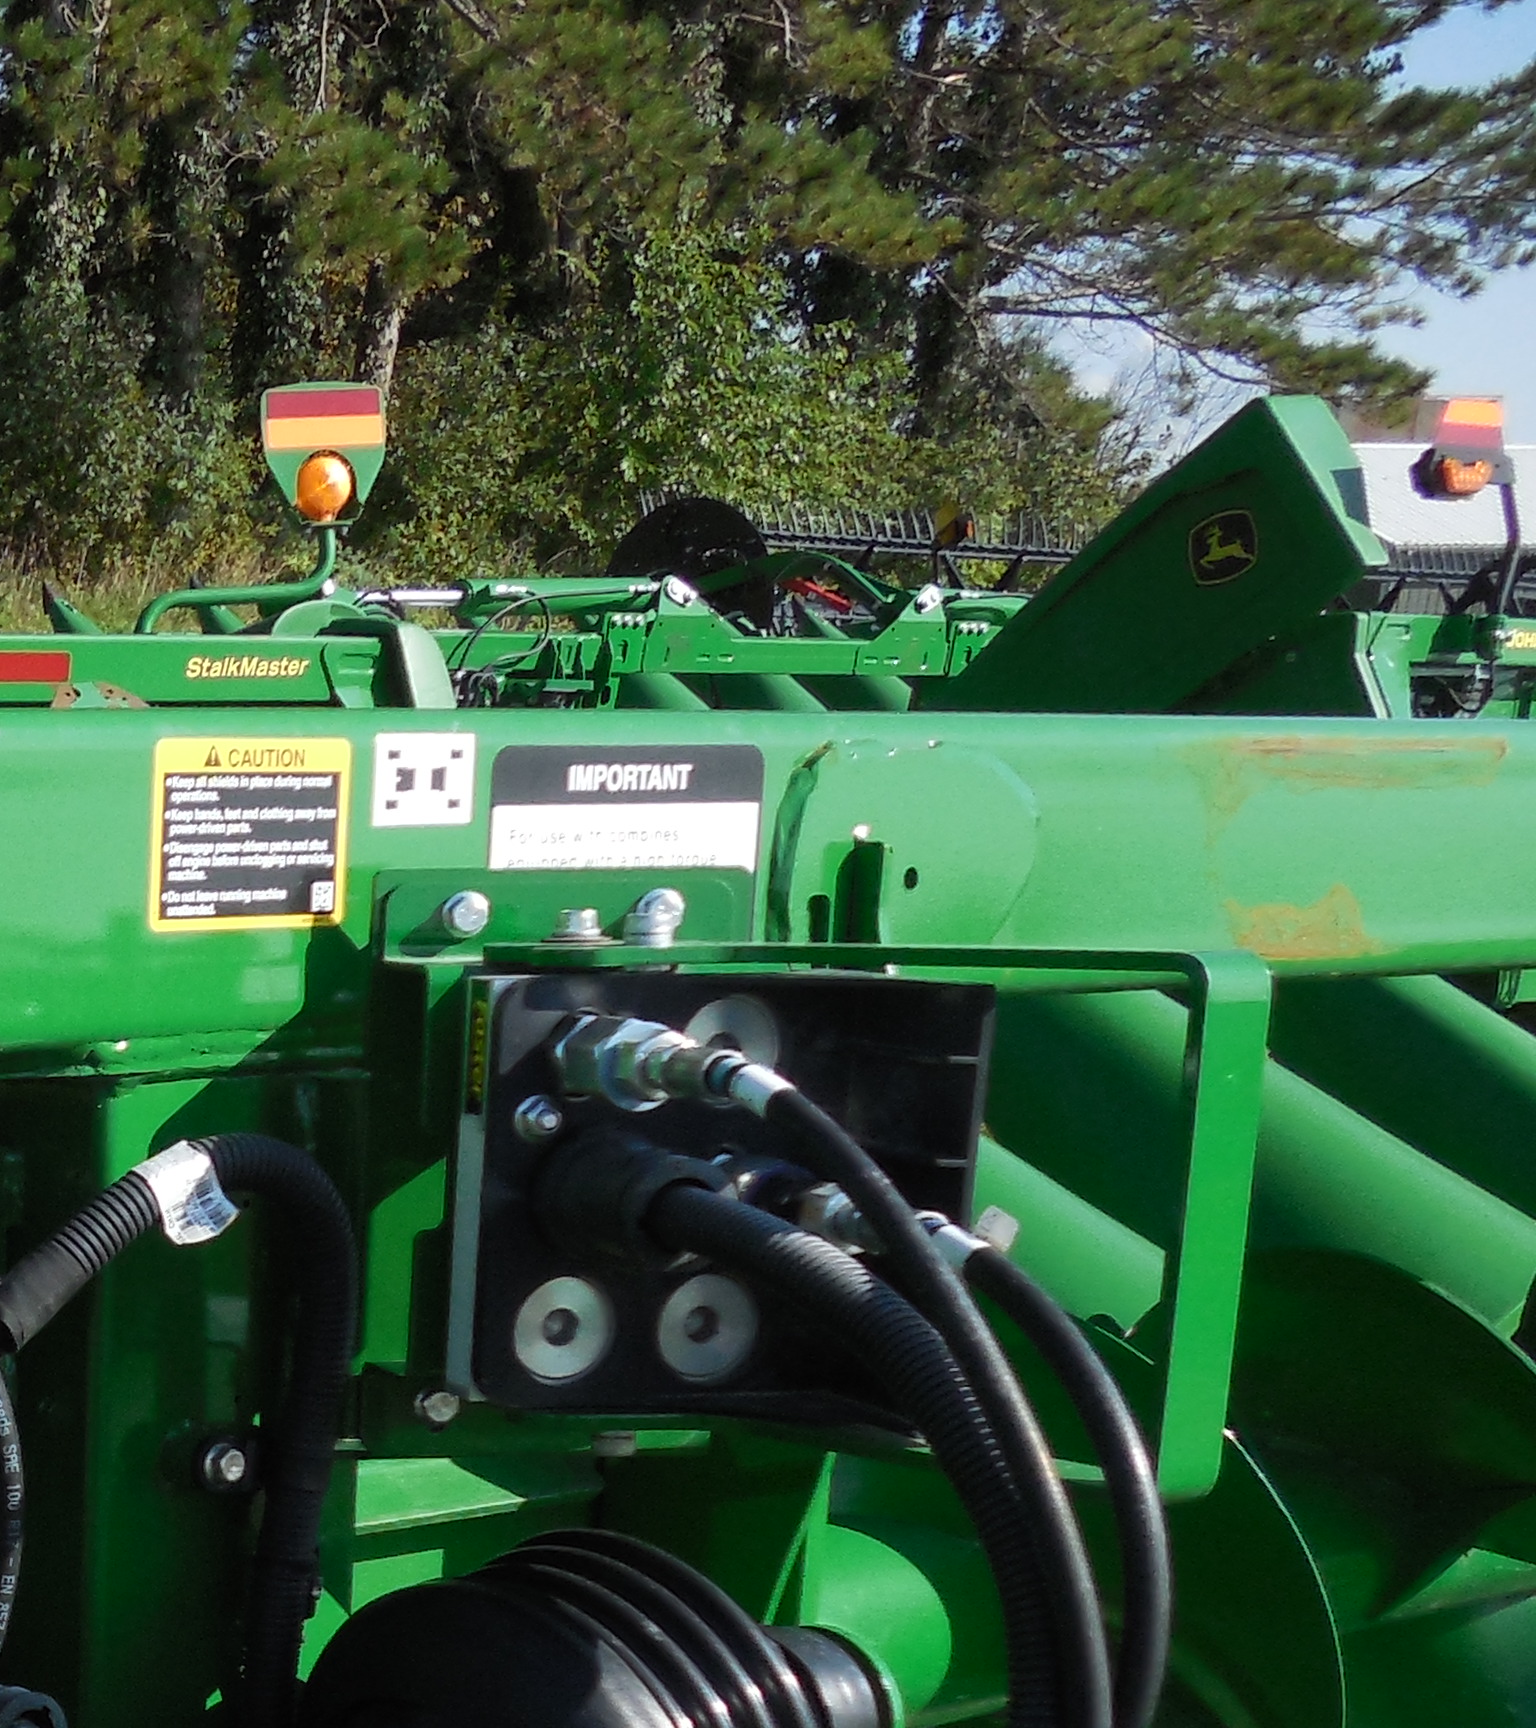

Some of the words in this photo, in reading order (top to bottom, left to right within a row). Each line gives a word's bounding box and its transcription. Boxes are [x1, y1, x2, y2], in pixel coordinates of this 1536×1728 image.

[185, 655, 310, 679] StalkMaster
[228, 748, 306, 768] CAUTION
[567, 763, 694, 792] IMPORTANT
[2, 1443, 20, 1474] SAE
[5, 1483, 22, 1511] 100
[0, 1573, 16, 1596] EN
